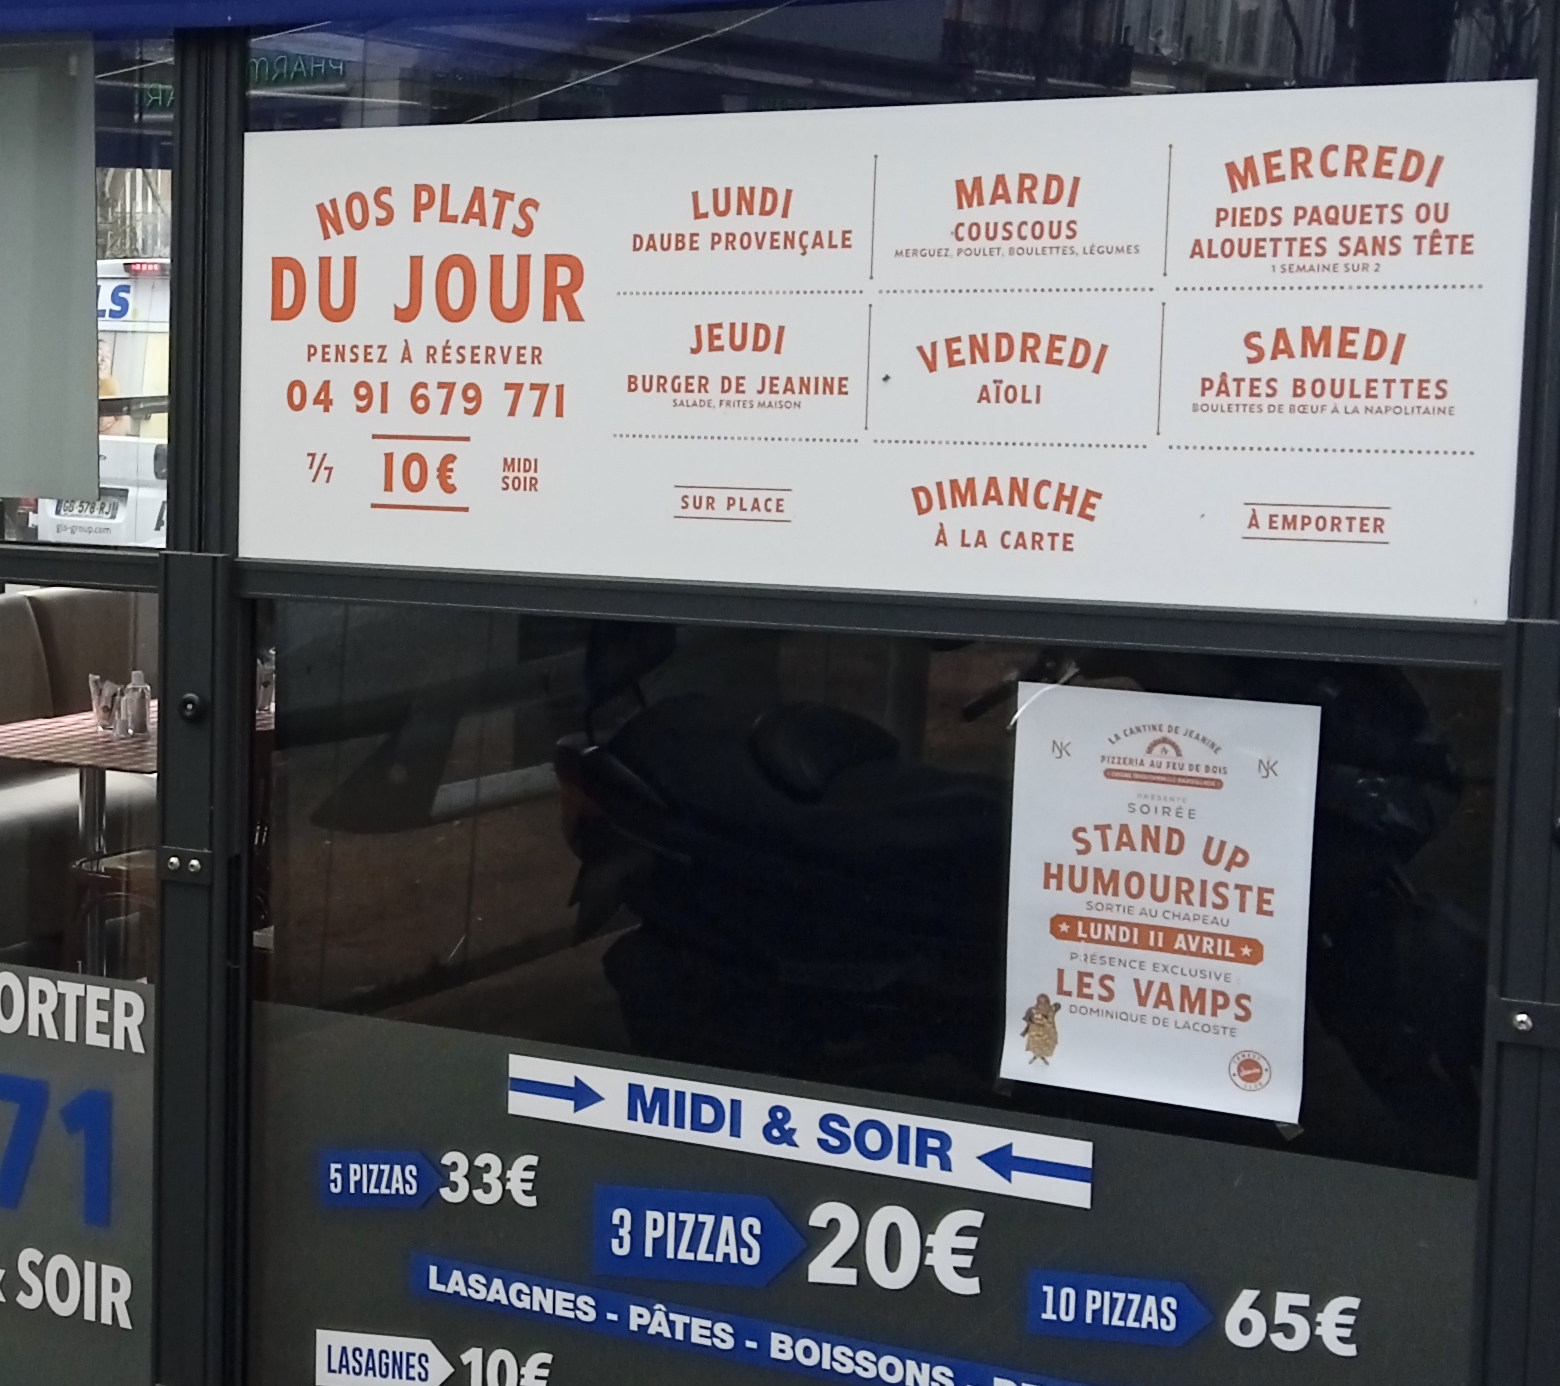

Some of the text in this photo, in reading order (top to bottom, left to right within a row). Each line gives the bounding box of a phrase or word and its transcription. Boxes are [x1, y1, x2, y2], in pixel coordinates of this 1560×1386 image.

[1224, 144, 1445, 193] MERCREDI
[691, 186, 793, 220] LUNDI
[954, 172, 1081, 210] MARDI
[315, 183, 540, 240] NOS PLATS
[1215, 202, 1449, 227] PIEDS PAQUETS OU
[632, 229, 852, 256] DAUBE PROVENÇALE
[954, 220, 1078, 242] COUSCOUS
[1190, 229, 1474, 259] ALOUETTES SANS TÊTE
[1272, 262, 1380, 273] 1 SEMAINE SUR 2
[271, 254, 585, 323] DU JOUR
[307, 339, 543, 365] PENSEZ À RÉSERVER
[689, 322, 786, 355] JEUDI
[916, 331, 1109, 374] VENDREDI
[1243, 325, 1407, 366] SAMEDI
[287, 380, 564, 417] 04 91 679 771
[627, 374, 849, 395] BURGER DE JEANINE
[977, 379, 1041, 404] AÏOLI
[1201, 372, 1448, 400] PÂTES BOULETTES
[1192, 403, 1263, 414] BOULETTES
[1267, 404, 1284, 414] DE
[1331, 402, 1340, 415] À
[1344, 405, 1360, 415] LA
[1364, 405, 1455, 416] NAPOLITAINE
[307, 452, 333, 483] 7/7
[503, 457, 538, 474] MIDI
[502, 476, 539, 492] SOIR
[911, 476, 1103, 522] DIMANCHE
[681, 495, 785, 513] SUR PLACE
[1248, 508, 1385, 534] À EMPORTER
[56, 524, 111, 534] gls-group.com
[935, 522, 1074, 552] À LA CARTE
[1128, 803, 1196, 819] SOIRÉE
[1072, 823, 1250, 874] STAND UP
[1043, 862, 1275, 918] HUMOURISTE
[1086, 900, 1229, 928] SORTIE AU CHAPEAU
[1077, 920, 1139, 945] LUNDI
[1174, 934, 1235, 958] AVRIL
[1070, 952, 1232, 983] PRÉSENCE EXCLUSIVE
[1056, 968, 1253, 1023] LES VAMPS
[1070, 1005, 1237, 1038] DOMINIQUE DE LACOSTE
[627, 1083, 954, 1174] MIDI & SOIR
[329, 1163, 418, 1198] 5 PIZZAS
[439, 1150, 539, 1207] 33€
[610, 1210, 762, 1267] 3 PIZZAS
[807, 1200, 985, 1297] 20€
[17, 1246, 134, 1330] SOIR
[426, 1264, 597, 1325] LASAGNES
[628, 1302, 736, 1351] PÂTES
[1040, 1284, 1179, 1332] 10 PIZZAS
[1223, 1288, 1362, 1358] 65€
[326, 1342, 430, 1384] LASAGNES
